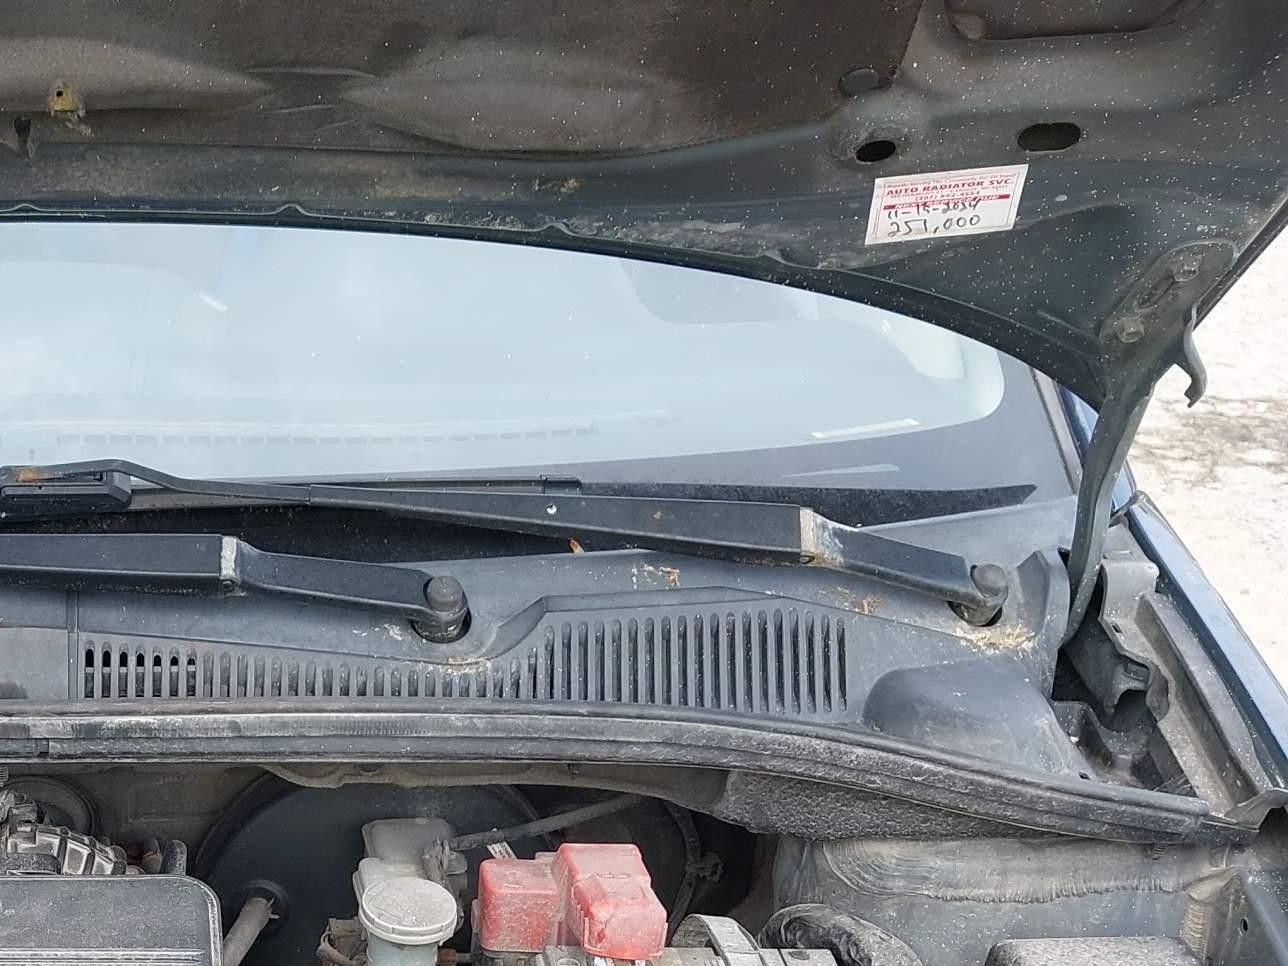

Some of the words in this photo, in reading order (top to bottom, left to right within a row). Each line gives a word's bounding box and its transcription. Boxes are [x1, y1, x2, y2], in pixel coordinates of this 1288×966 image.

[886, 186, 919, 196] AUTO
[923, 181, 984, 192] RADIATOR
[987, 178, 1014, 186] SVC
